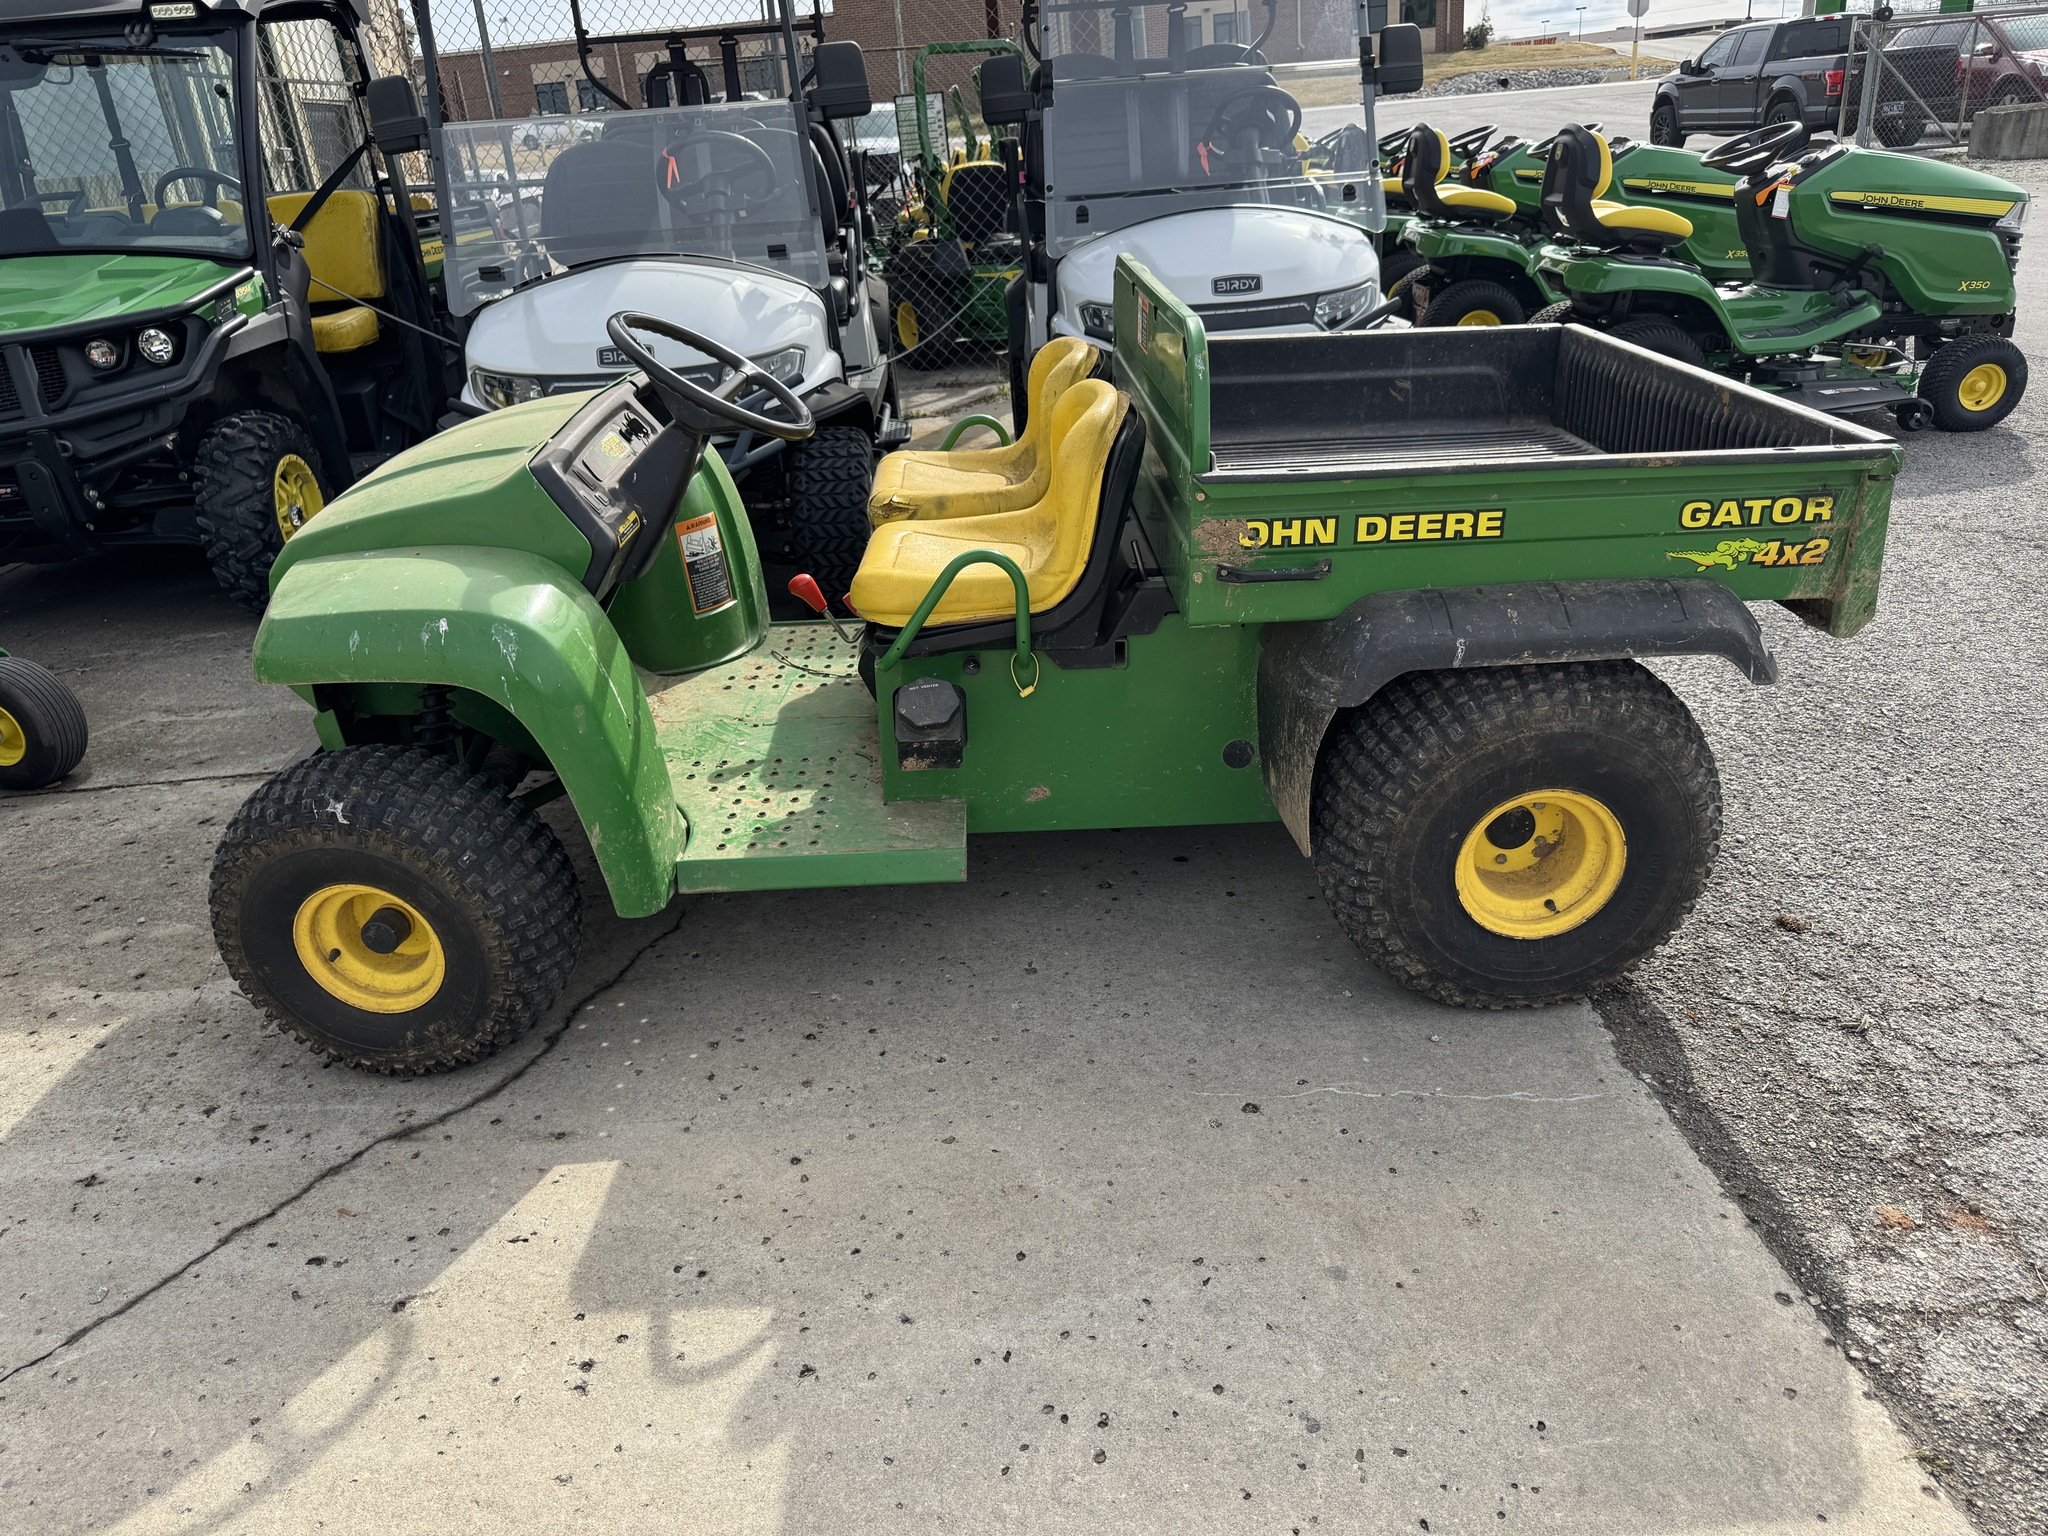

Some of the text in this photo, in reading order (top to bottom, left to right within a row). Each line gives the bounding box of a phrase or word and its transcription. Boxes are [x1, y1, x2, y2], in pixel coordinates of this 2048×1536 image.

[1646, 180, 1697, 193] JOHN DEERE
[1860, 193, 1925, 208] JOHN DEERE
[1216, 278, 1258, 292] BIRDY
[1957, 280, 1991, 292] X350
[602, 350, 628, 363] BIR
[1680, 494, 1834, 529] GATOR
[1238, 510, 1504, 549] OHN DEERE
[1751, 537, 1830, 567] 4x2
